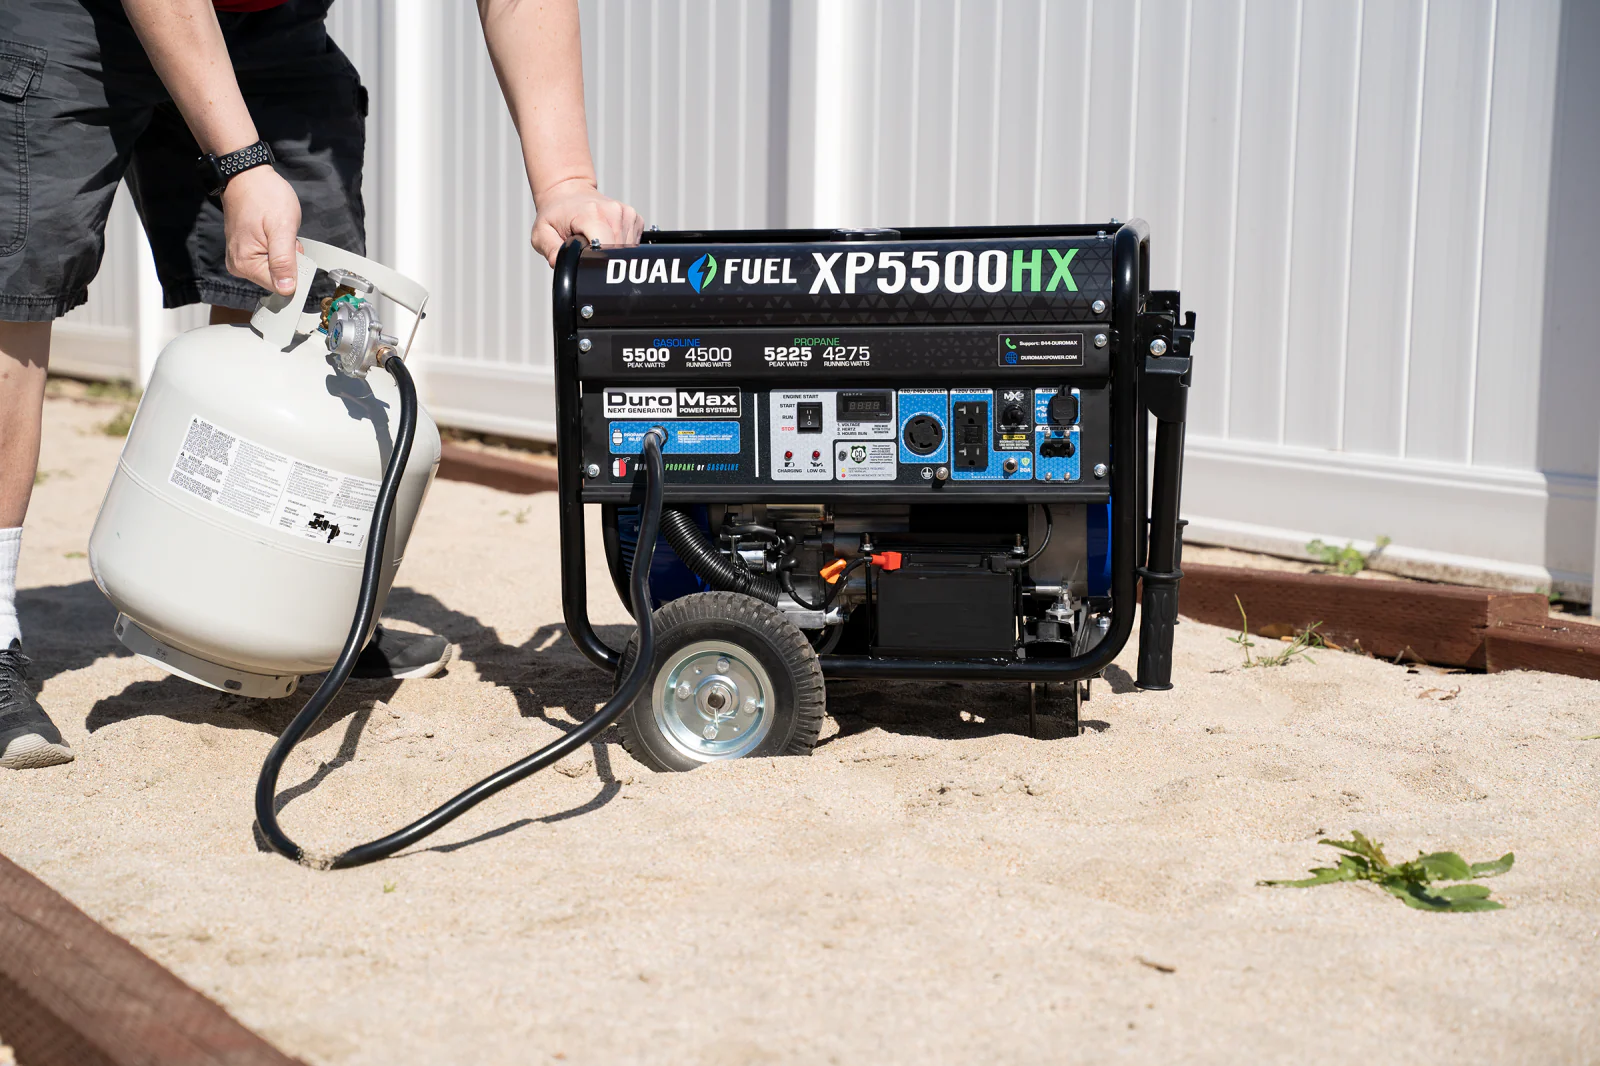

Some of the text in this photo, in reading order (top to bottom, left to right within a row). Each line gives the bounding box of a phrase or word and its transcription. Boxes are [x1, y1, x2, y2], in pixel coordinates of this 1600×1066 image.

[606, 248, 1079, 294] DUAL FUEL XP5500HX
[653, 338, 700, 347] GASOLINE
[794, 338, 840, 346] PROPANE
[622, 347, 732, 362] 5500 4500
[764, 346, 870, 361] 5225 4275
[608, 392, 737, 406] Duro Max
[855, 450, 862, 458] CO
